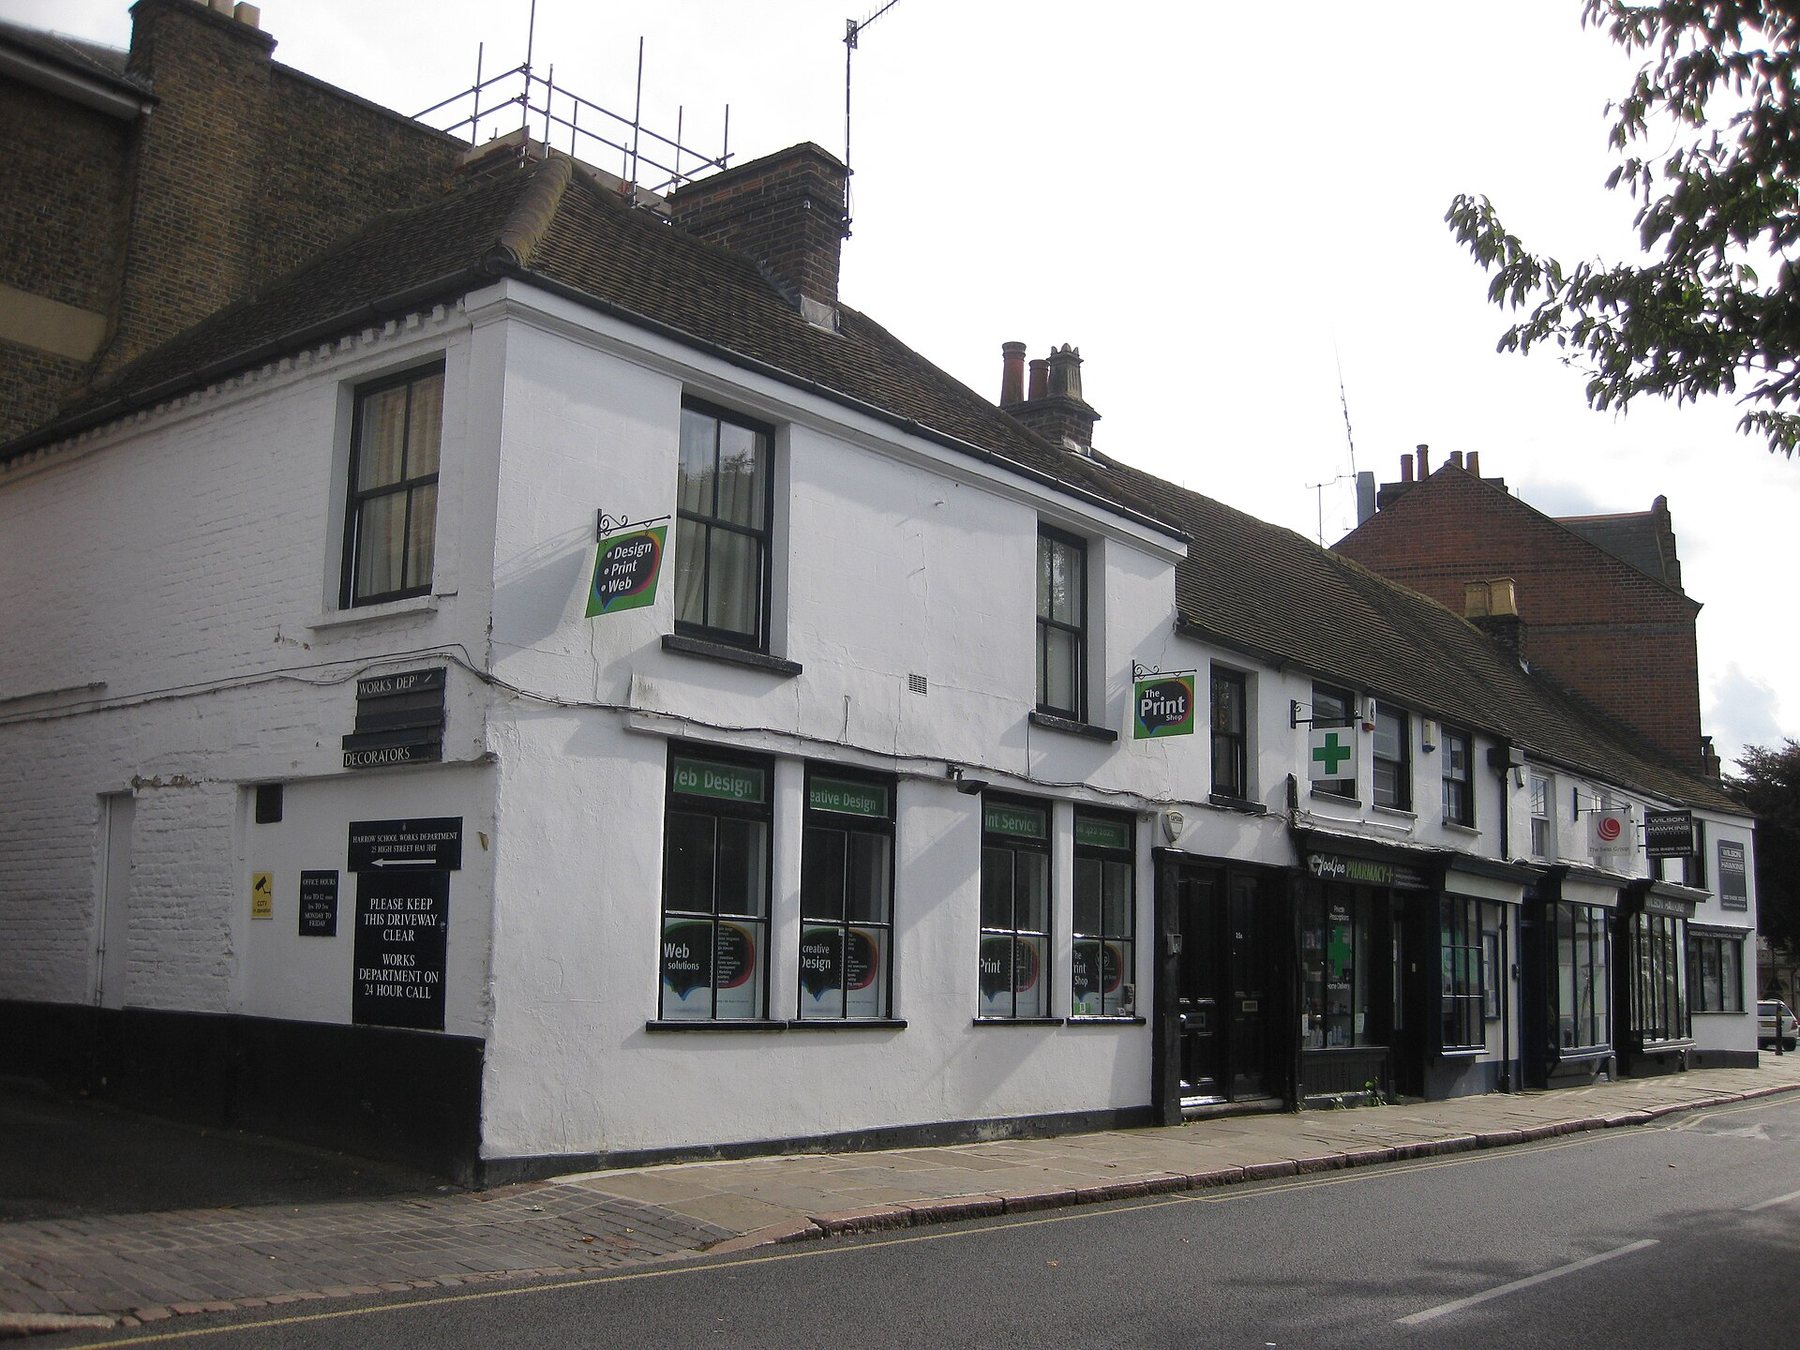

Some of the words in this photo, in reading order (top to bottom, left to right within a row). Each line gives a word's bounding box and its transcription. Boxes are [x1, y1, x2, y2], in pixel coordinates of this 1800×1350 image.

[614, 542, 652, 560] Design
[610, 560, 638, 576] Print
[608, 576, 632, 593] Web
[359, 679, 392, 694] WORKS
[1144, 688, 1160, 698] The
[1140, 696, 1185, 717] Print
[1166, 714, 1183, 722] Shop
[344, 746, 410, 766] DECORATORS
[673, 766, 698, 786] eb
[704, 770, 752, 798] Design
[842, 792, 876, 812] Design
[400, 833, 418, 841] WORKS
[420, 832, 458, 840] DEPARTMENT
[393, 844, 414, 852] STREET
[370, 898, 404, 910] PLEASE
[407, 898, 434, 910] KEEP
[364, 914, 384, 926] THIS
[387, 913, 438, 926] DRIVEWAY
[382, 929, 415, 942] CLEAR
[664, 942, 690, 958] Web
[802, 944, 830, 954] creative
[382, 954, 416, 967] WORKS
[668, 960, 700, 970] solutions
[359, 968, 422, 982] DEPARTMENT
[424, 970, 439, 983] ON
[1074, 975, 1089, 988] Shop
[364, 983, 374, 996] 24
[376, 984, 403, 997] HOUR
[406, 985, 432, 999] CALL
